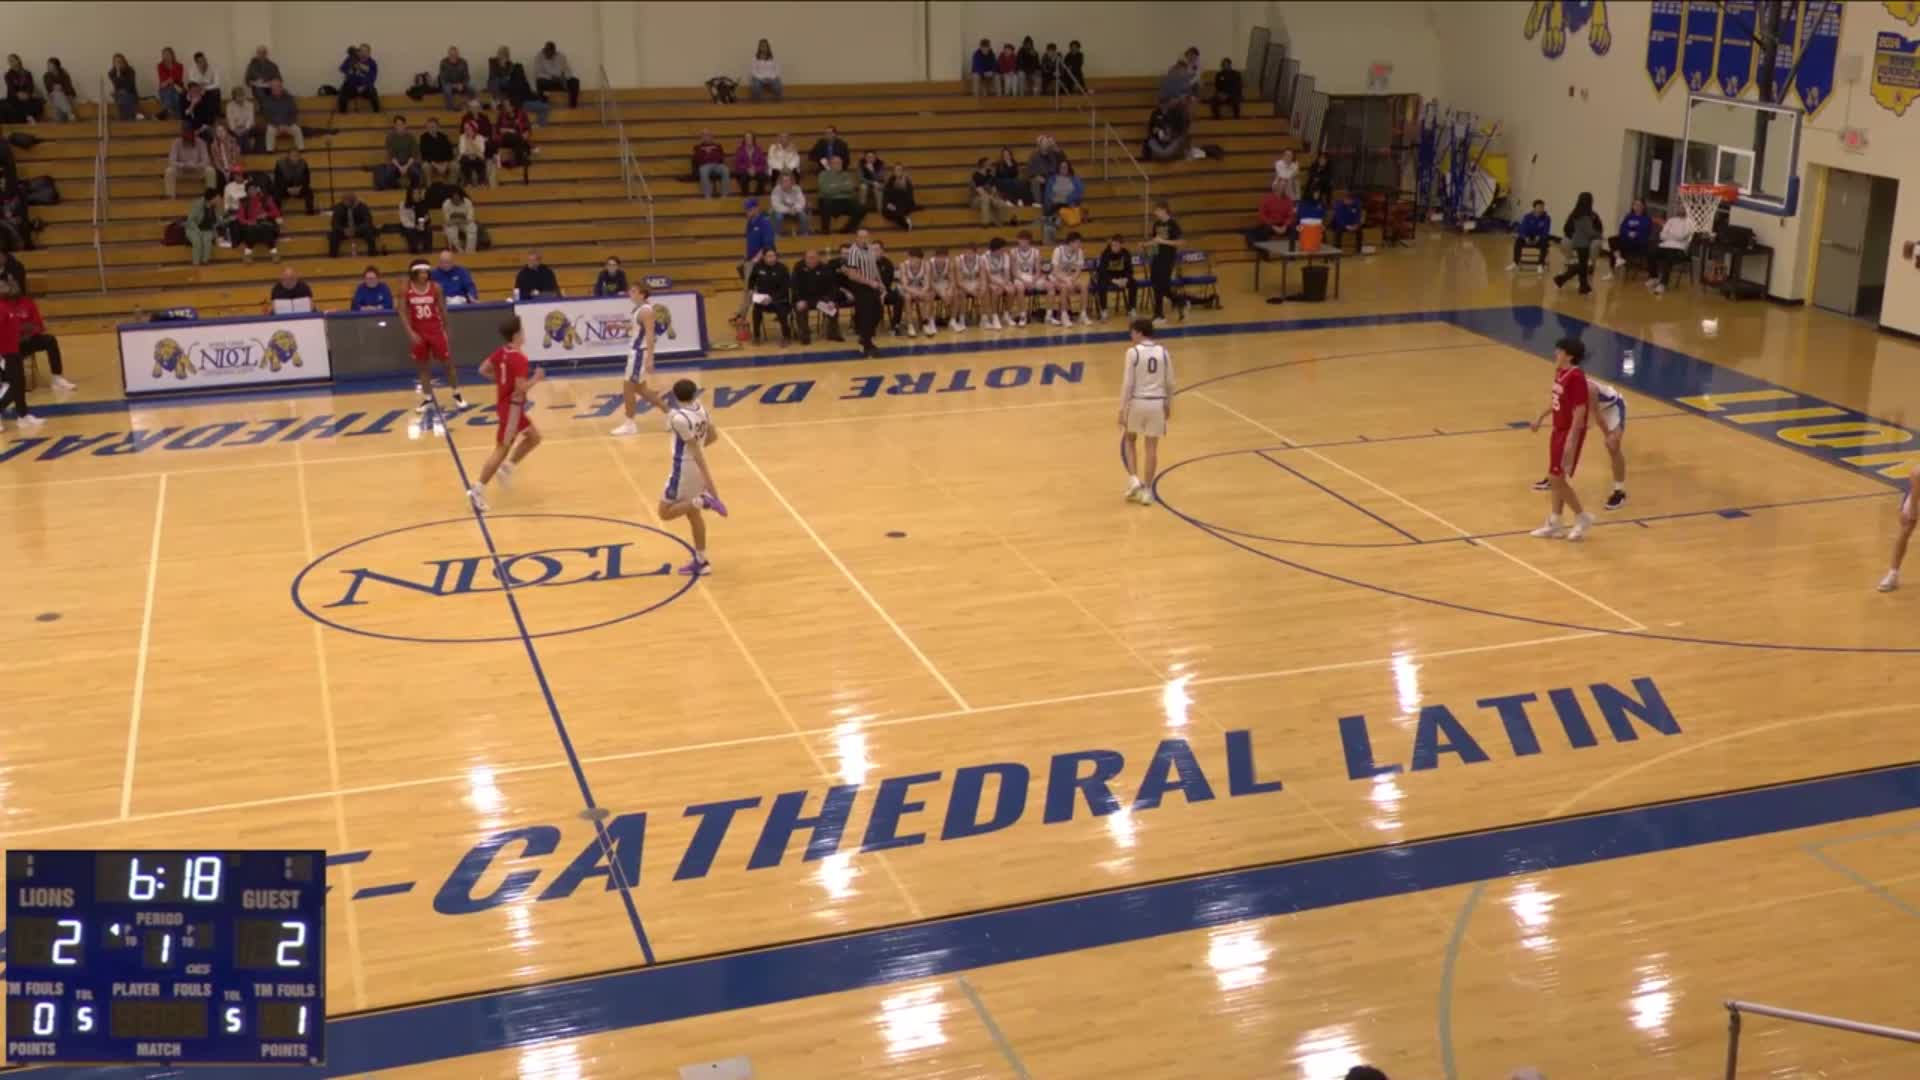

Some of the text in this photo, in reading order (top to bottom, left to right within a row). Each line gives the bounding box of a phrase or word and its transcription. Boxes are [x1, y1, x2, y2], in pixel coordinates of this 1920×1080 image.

[415, 305, 433, 319] 30
[500, 361, 506, 384] 1
[1148, 356, 1157, 373] 0
[840, 361, 1085, 400] NOTRE
[1338, 676, 1683, 781] LATIN
